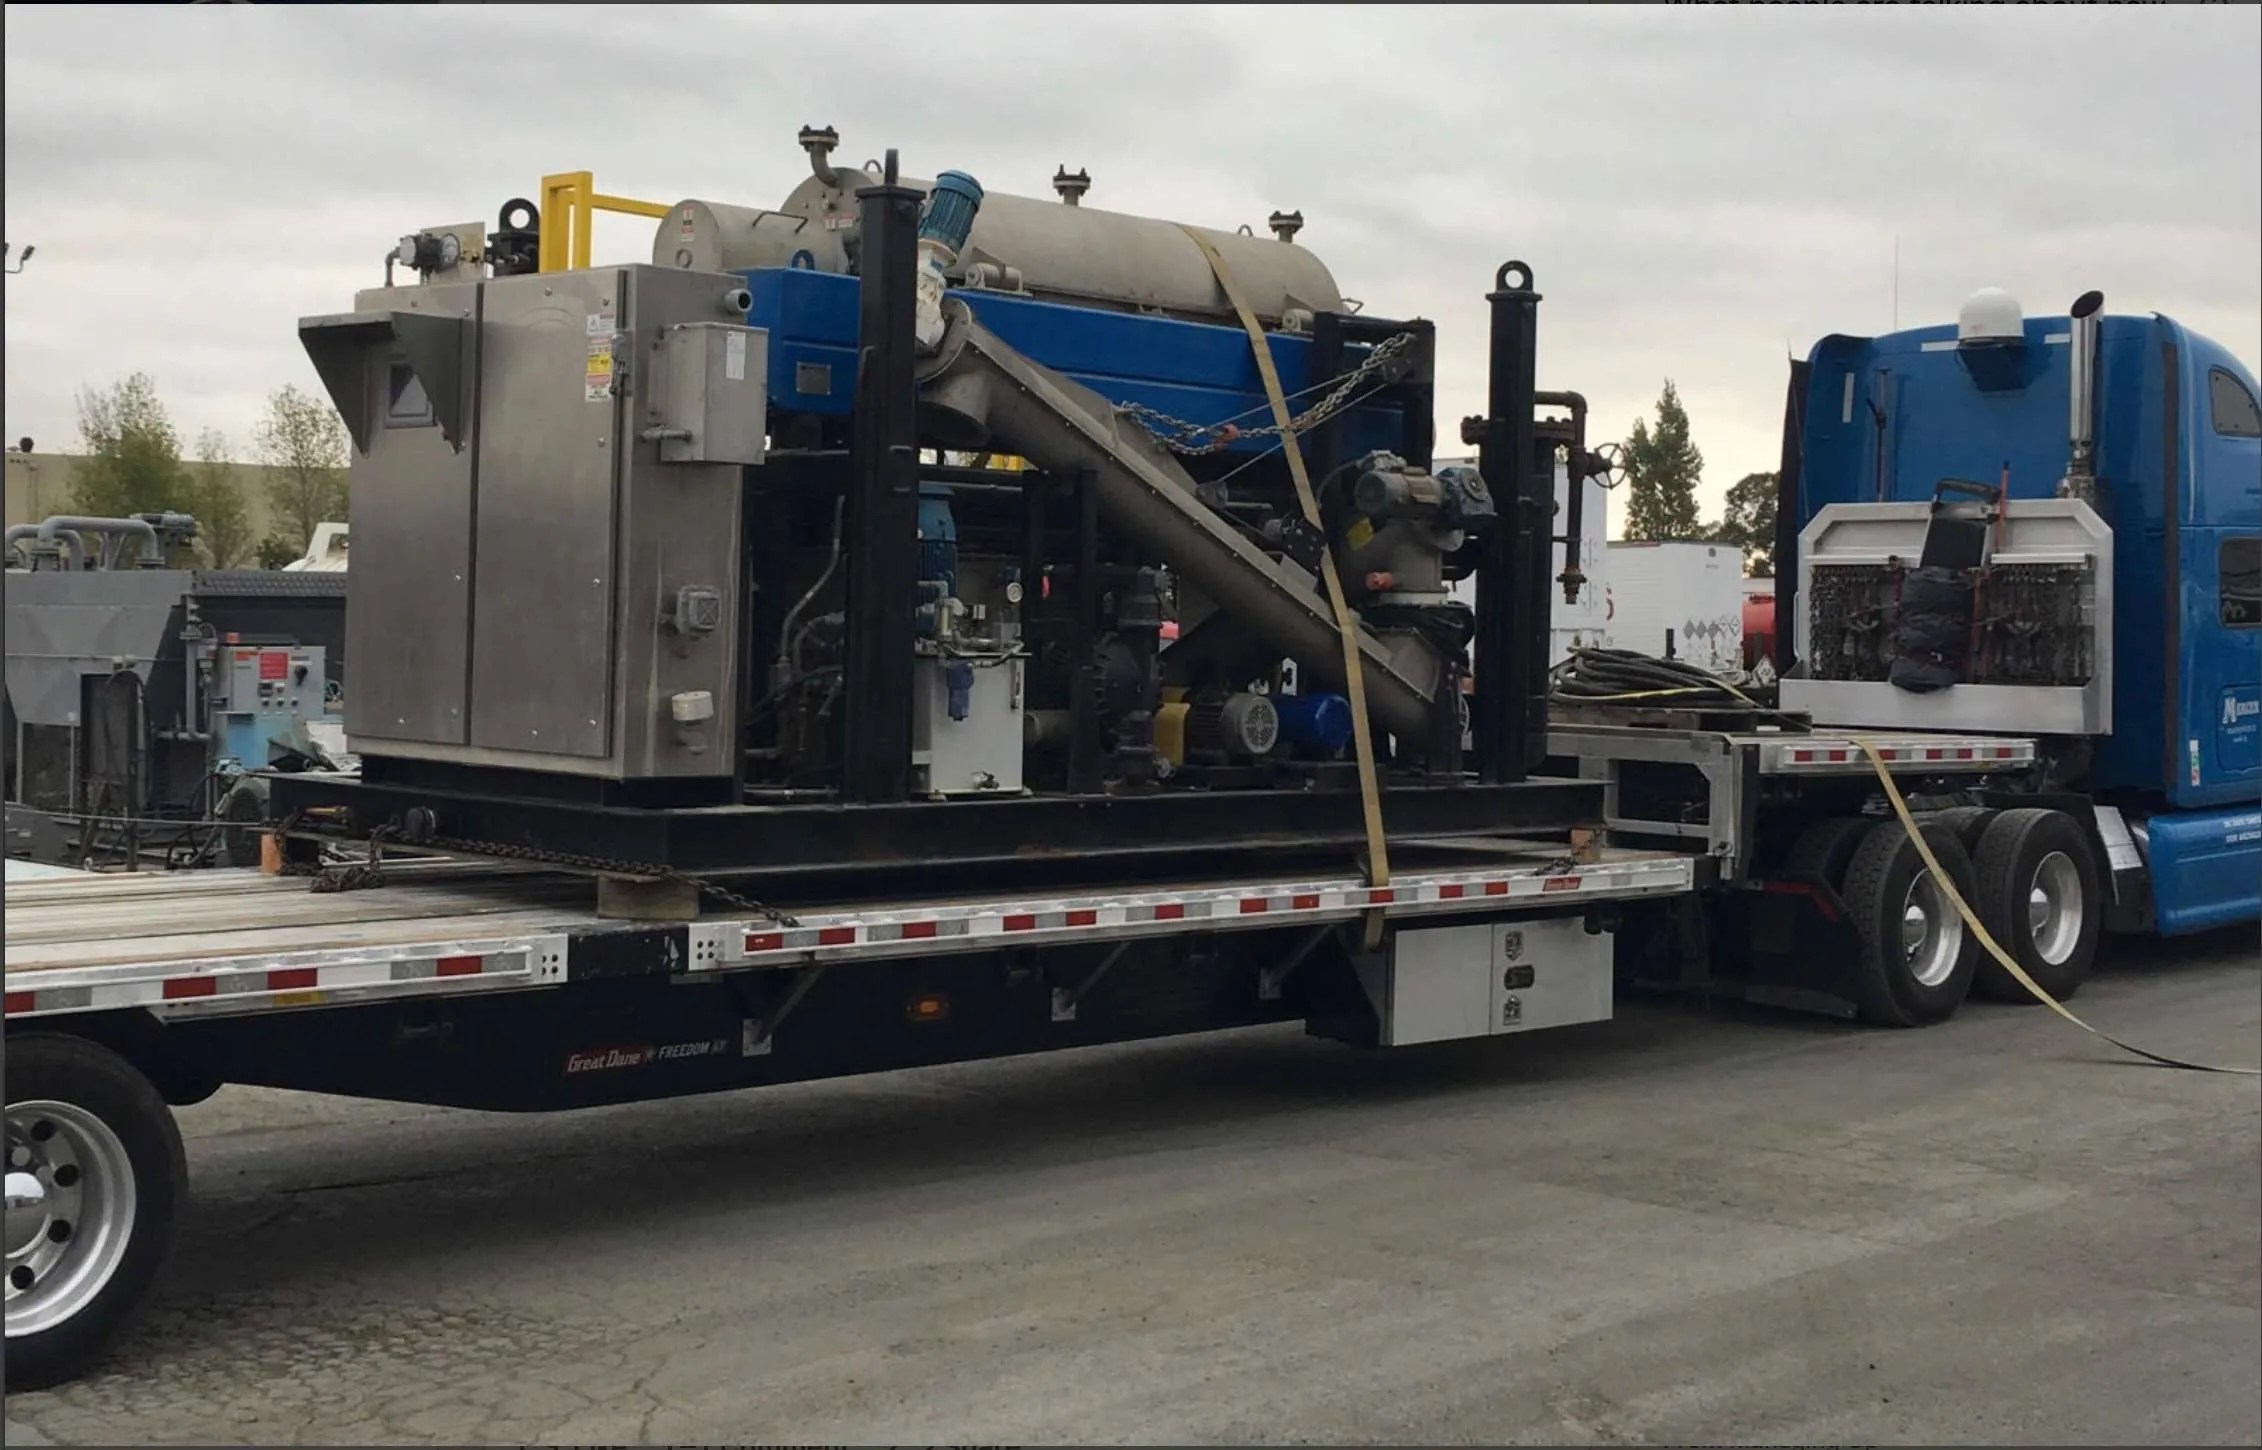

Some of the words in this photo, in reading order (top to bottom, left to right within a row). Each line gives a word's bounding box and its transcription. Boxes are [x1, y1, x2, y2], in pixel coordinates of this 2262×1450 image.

[567, 1053, 607, 1073] Great
[606, 1049, 641, 1068] Dane
[658, 1040, 711, 1061] FREEDOM
